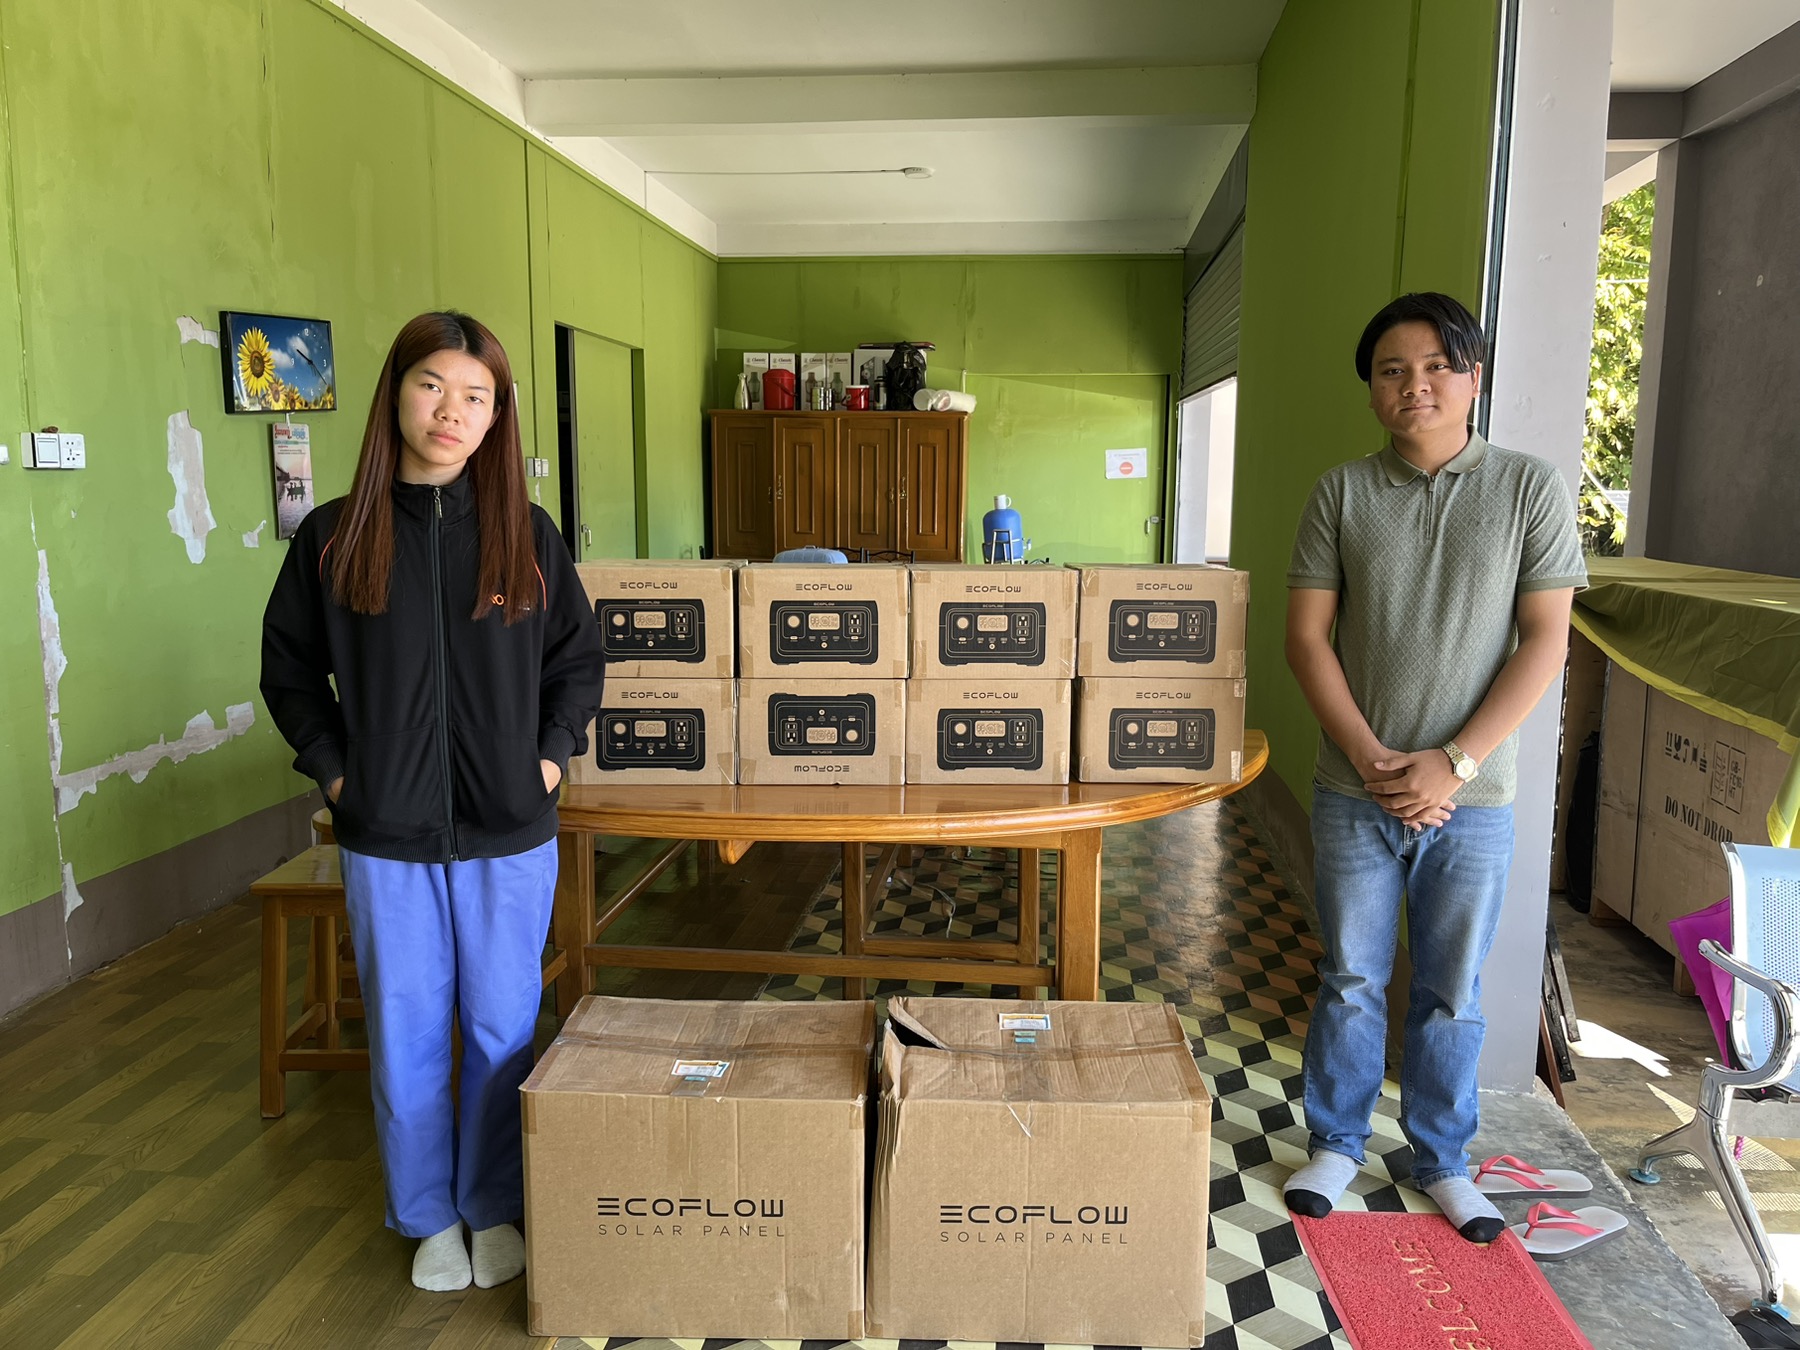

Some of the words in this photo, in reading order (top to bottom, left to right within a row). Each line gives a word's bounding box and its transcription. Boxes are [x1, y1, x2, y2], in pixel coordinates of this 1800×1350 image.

[619, 581, 678, 590] ECOFLOW
[795, 583, 853, 591] ECOFLOW
[965, 585, 1022, 593] ECOFLOW
[1136, 583, 1193, 591] ECOFLOW
[621, 691, 679, 699] ECOFLOW
[963, 692, 1019, 700] ECOFLOW
[1135, 692, 1191, 700] ECOFLOW
[1665, 795, 1678, 818] DO
[1680, 804, 1701, 831] NOT
[1703, 817, 1733, 843] DROP
[597, 1198, 784, 1218] ECOFLOW
[940, 1205, 1128, 1225] ECOFLOW
[598, 1224, 682, 1236] SOLAR
[703, 1225, 785, 1237] PANEL
[940, 1231, 1025, 1243] SOLAR
[1046, 1232, 1128, 1244] PANEL
